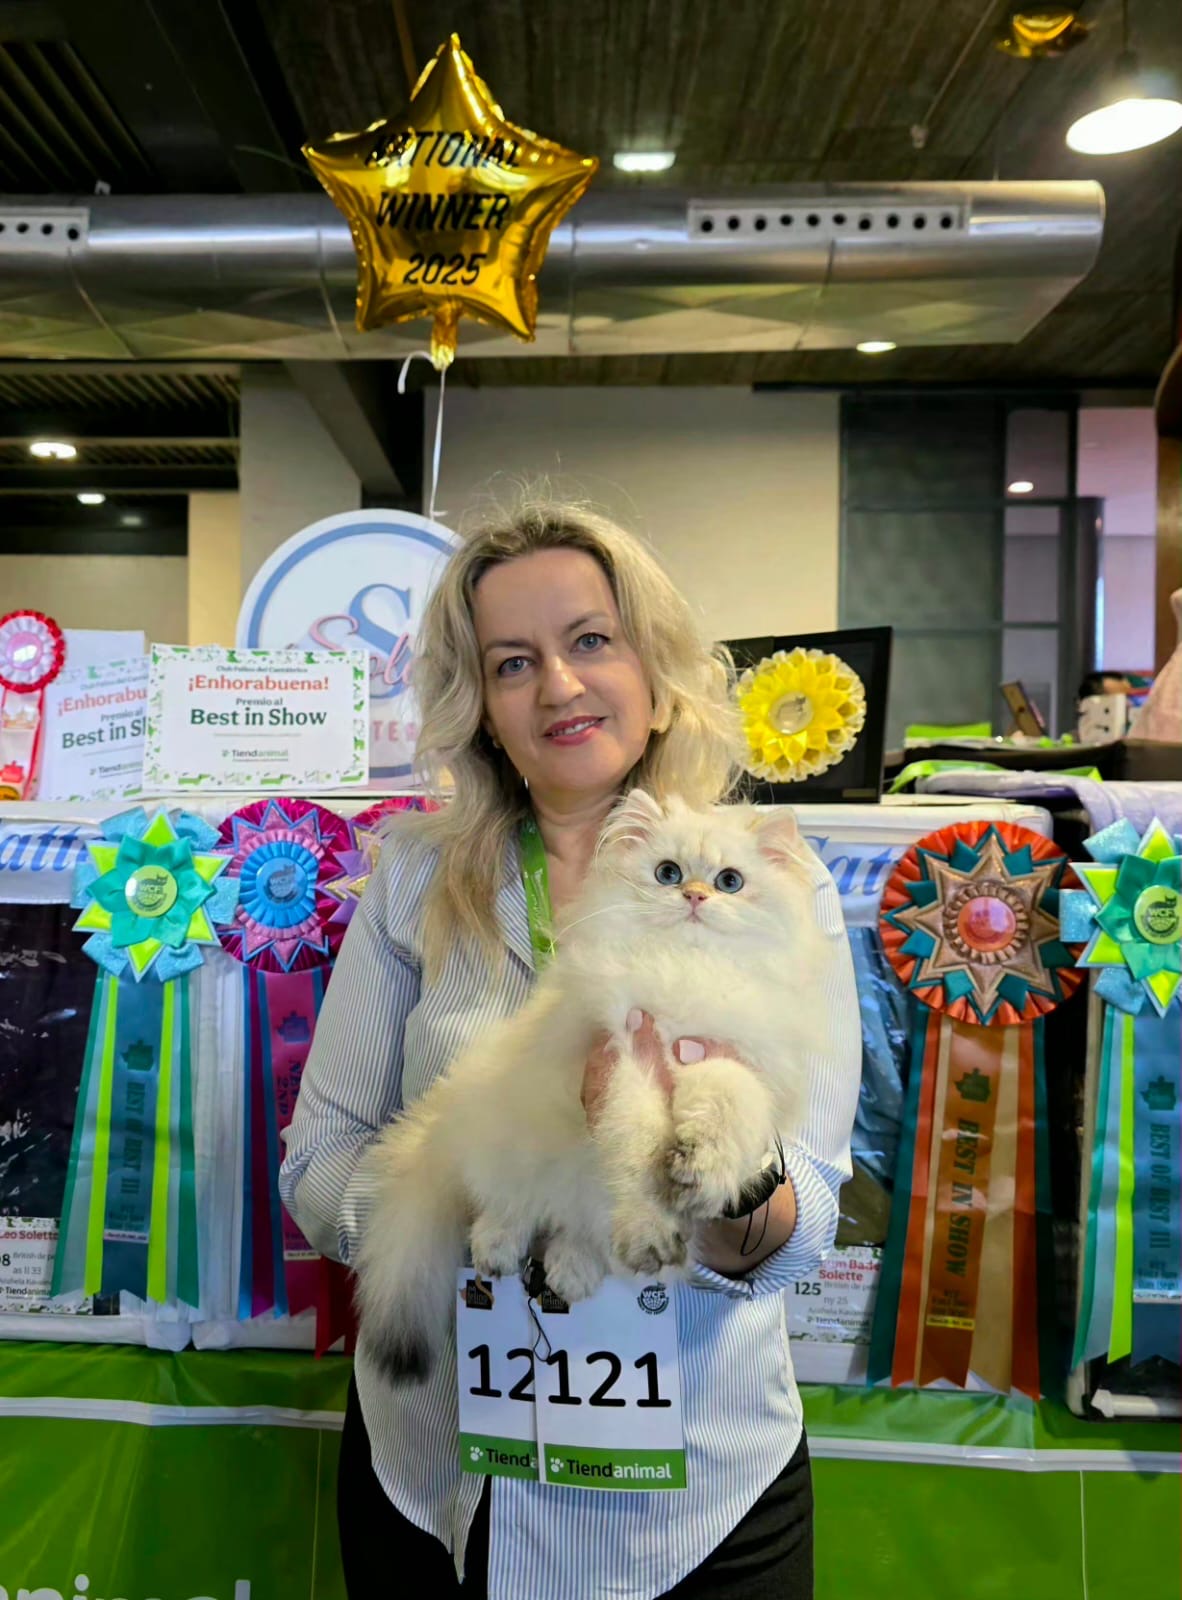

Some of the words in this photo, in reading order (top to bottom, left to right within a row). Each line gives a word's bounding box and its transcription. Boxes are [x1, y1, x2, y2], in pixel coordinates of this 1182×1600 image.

[365, 130, 520, 168] NATIONAL
[375, 192, 511, 231] WINNER
[403, 253, 486, 285] 2025
[188, 675, 329, 692] ¡Enhorabuena!
[236, 697, 272, 705] Premio
[274, 697, 283, 705] al
[191, 708, 239, 726] Best
[245, 706, 264, 726] in
[269, 708, 327, 726] Show
[62, 728, 104, 749] Best
[110, 722, 126, 741] in
[956, 1118, 979, 1175] BEST
[1150, 1123, 1171, 1160] BEST
[1150, 1164, 1172, 1186] OF
[952, 1181, 973, 1208] IN
[946, 1215, 972, 1278] SHOW
[1149, 1231, 1171, 1249] III
[0, 1253, 11, 1266] 8
[795, 1281, 821, 1296] 125
[818, 1269, 863, 1281] Solette
[468, 1344, 536, 1403] 12
[547, 1350, 672, 1408] 121
[567, 1459, 672, 1480] Tiendanimal
